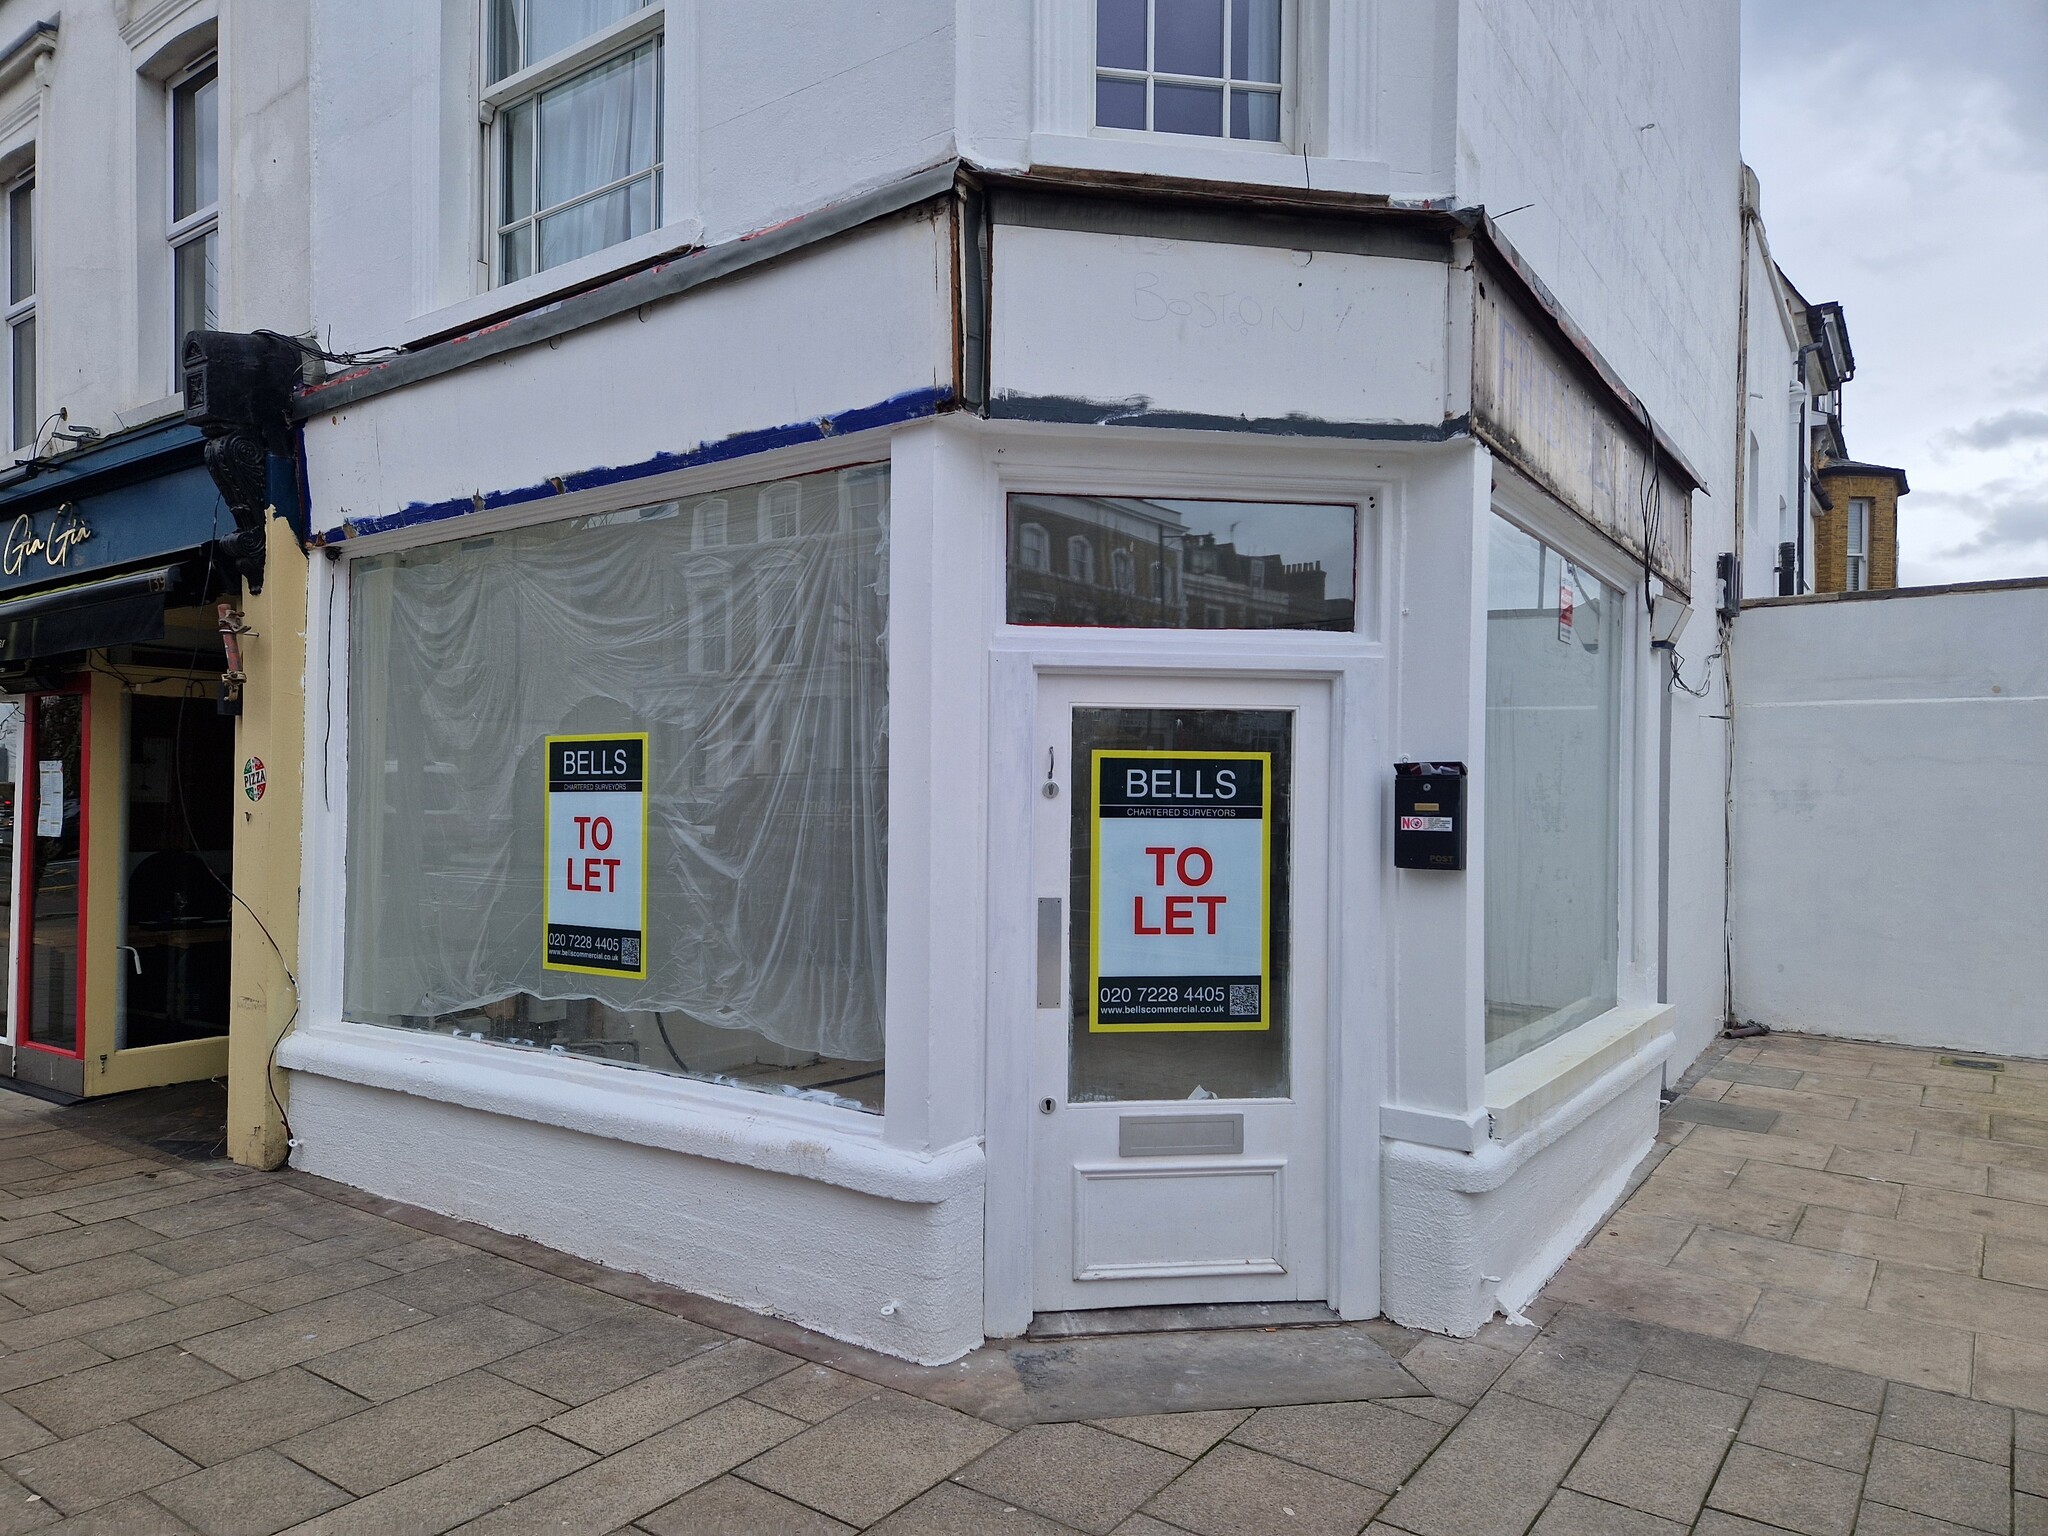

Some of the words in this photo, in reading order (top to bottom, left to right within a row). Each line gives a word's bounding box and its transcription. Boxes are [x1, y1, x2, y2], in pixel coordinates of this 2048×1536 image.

[563, 749, 627, 775] BELLS
[244, 770, 266, 788] PIZZA
[563, 783, 594, 791] CHARTERED
[594, 783, 627, 791] SURVEYORS
[1126, 769, 1237, 799] BELLS
[1126, 808, 1180, 817] CHARTERED
[1182, 808, 1236, 817] SURVEYORS
[573, 816, 613, 851] TO
[1145, 846, 1214, 888] TO
[1430, 854, 1454, 862] POST
[567, 858, 621, 893] LET
[1134, 896, 1227, 935] LET
[548, 932, 566, 947] 020
[568, 934, 592, 949] 7228
[594, 937, 619, 952] 4405
[548, 948, 619, 961] www.bellscommercial.co.uk
[1100, 987, 1132, 1003] 020
[1137, 986, 1179, 1002] 7228
[1183, 986, 1225, 1002] 4405
[1100, 1004, 1225, 1014] www.bellscommercial.co.uk
